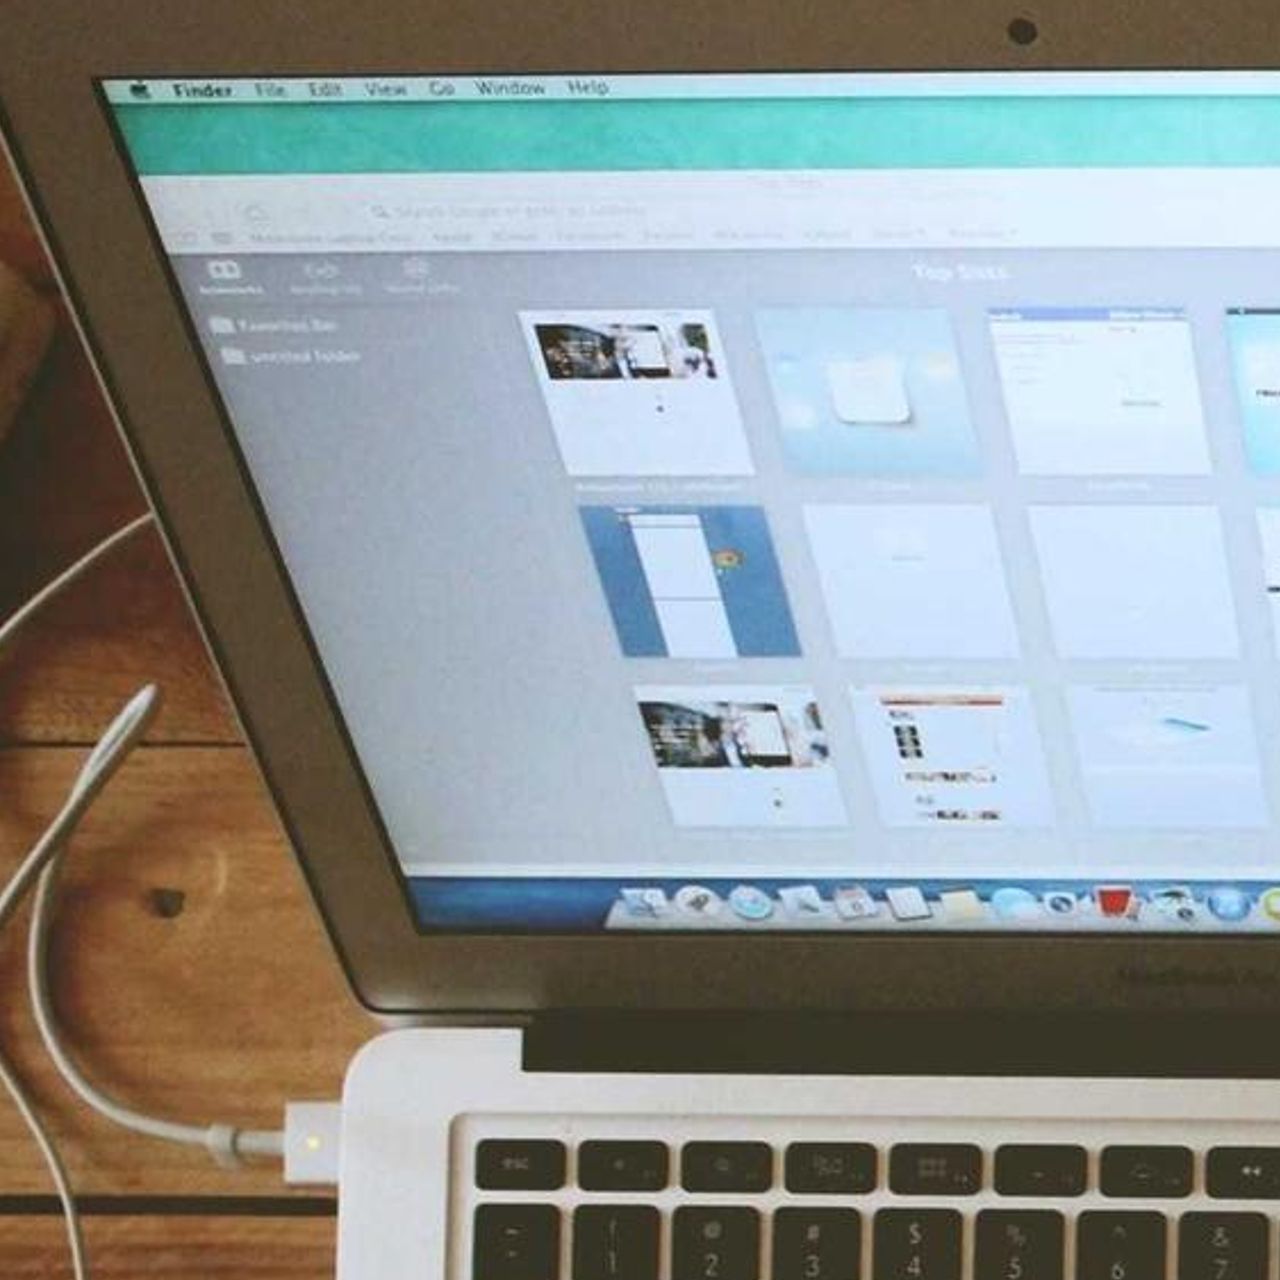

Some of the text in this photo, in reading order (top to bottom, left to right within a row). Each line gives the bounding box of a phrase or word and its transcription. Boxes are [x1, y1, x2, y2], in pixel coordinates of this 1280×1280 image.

[172, 83, 233, 98] Finder
[308, 82, 343, 97] Edit
[363, 81, 407, 96] View
[429, 80, 455, 96] Go
[473, 79, 546, 96] Window
[567, 79, 610, 96] Help
[501, 1157, 529, 1170] esc
[705, 1252, 719, 1277] 2
[805, 1254, 821, 1278] 3
[906, 1255, 921, 1276] 4
[1007, 1256, 1022, 1280] 5
[1110, 1262, 1126, 1280] 6
[1214, 1258, 1229, 1280] 7
